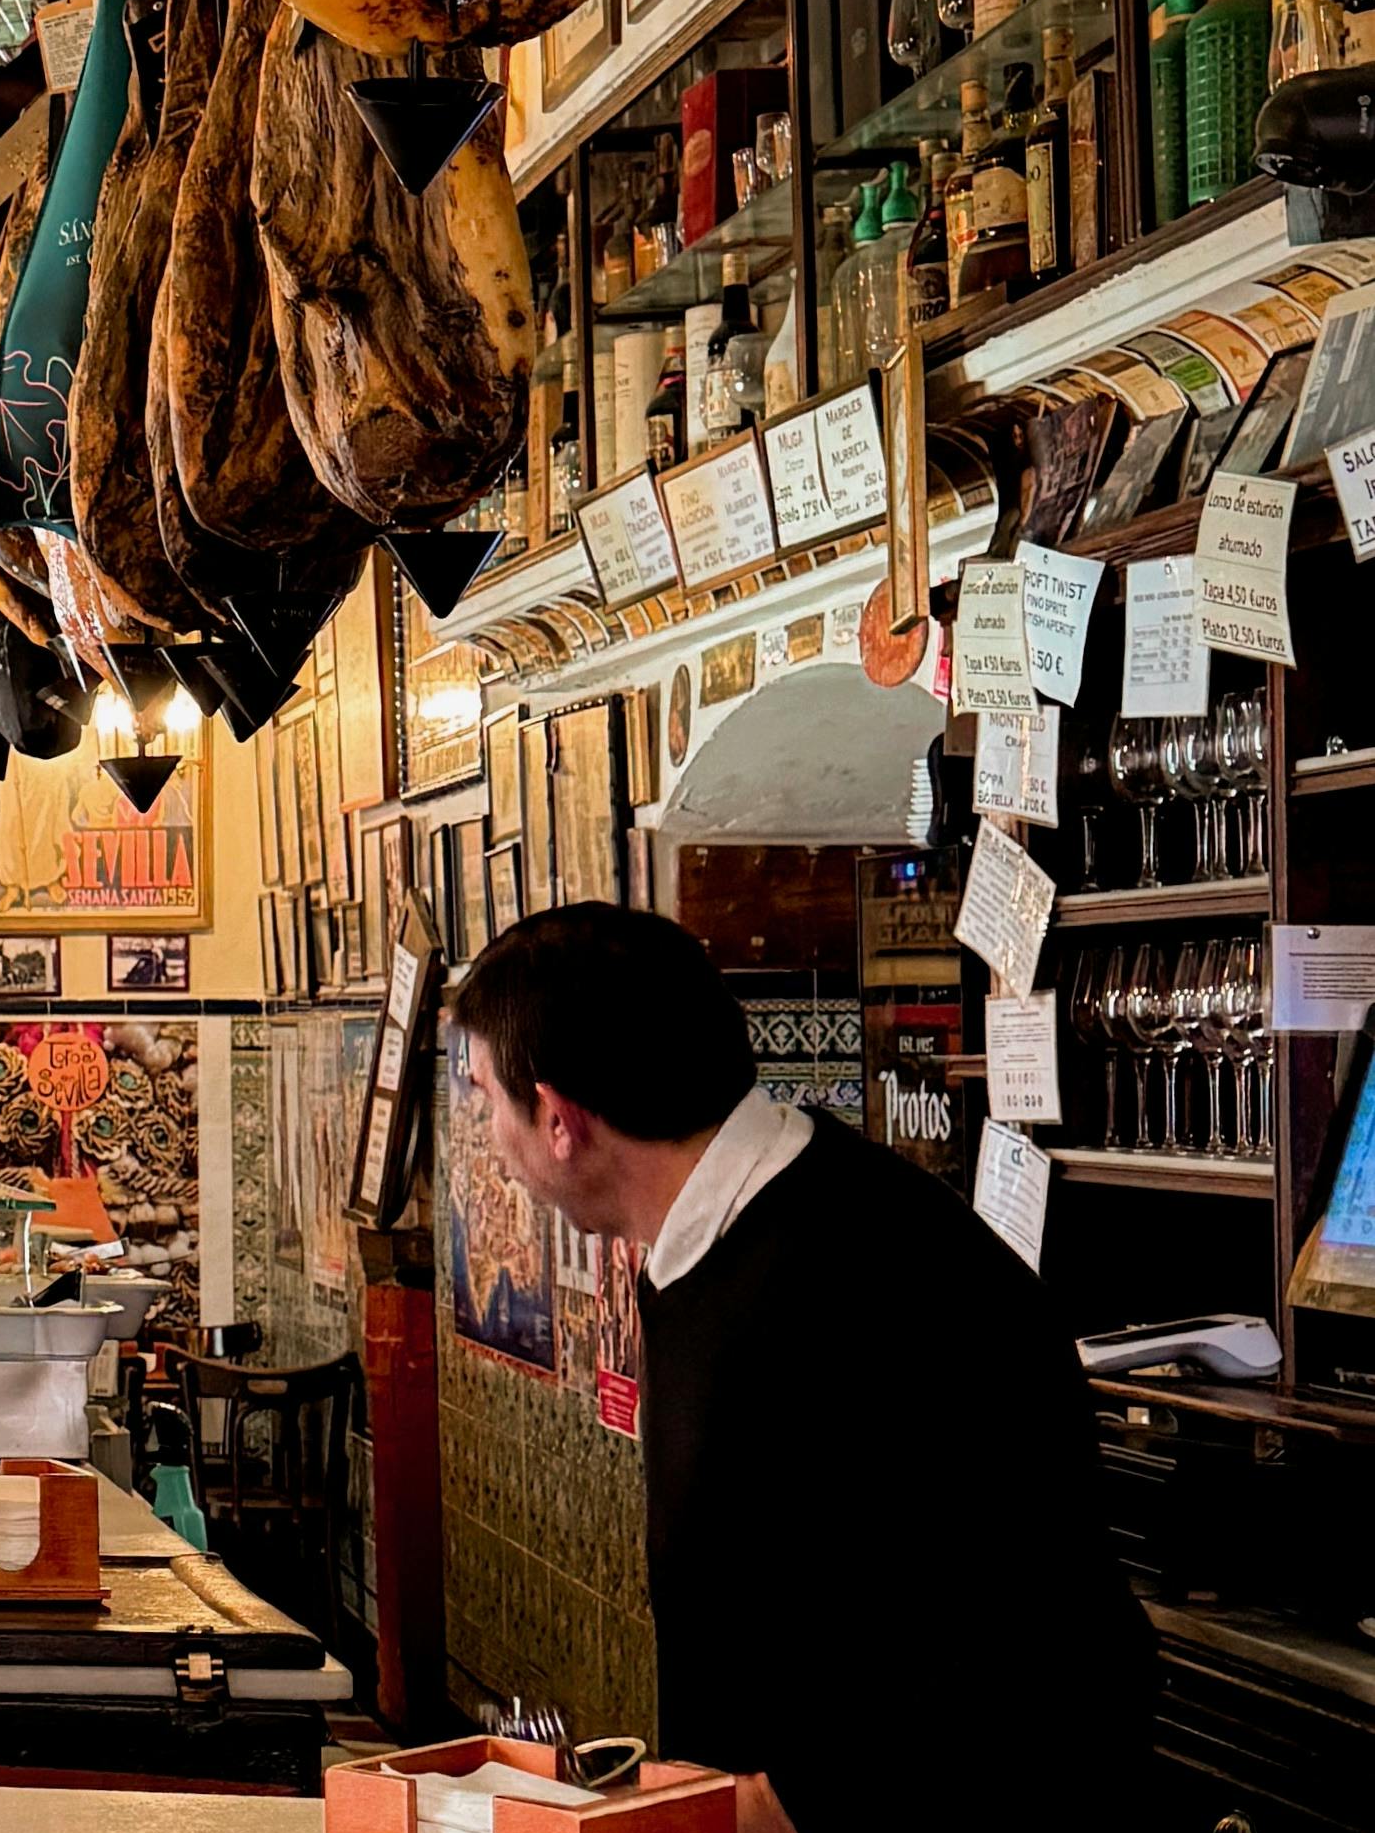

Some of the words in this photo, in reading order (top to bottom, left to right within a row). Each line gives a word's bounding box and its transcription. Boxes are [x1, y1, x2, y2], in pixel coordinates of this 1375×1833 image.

[1218, 533, 1262, 558] ahumado
[1053, 577, 1087, 601] TWIST
[1202, 618, 1228, 640] Plato
[62, 829, 193, 889] SEVILLA
[67, 889, 120, 906] SEMANA
[121, 888, 163, 905] SANTA
[163, 887, 195, 905] 1952
[44, 1040, 97, 1065] Toros
[37, 1069, 101, 1108] Sevilla
[878, 1069, 952, 1148] Protos
